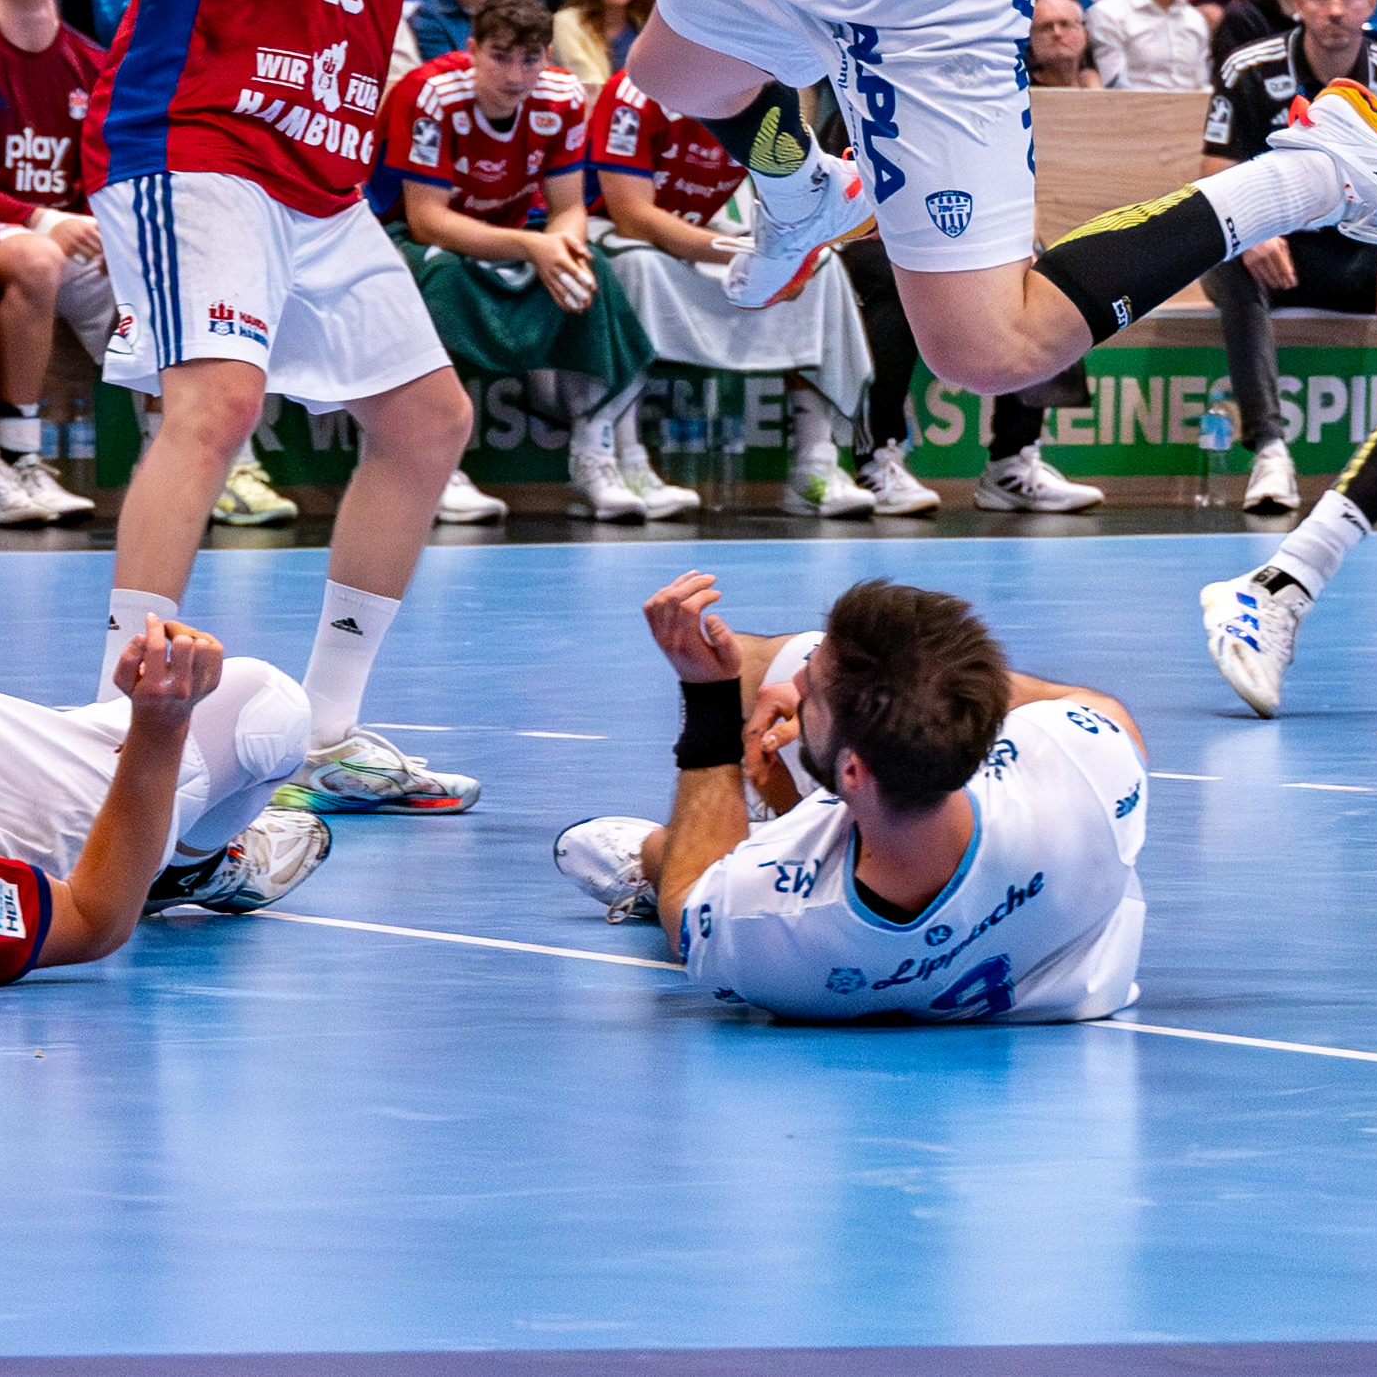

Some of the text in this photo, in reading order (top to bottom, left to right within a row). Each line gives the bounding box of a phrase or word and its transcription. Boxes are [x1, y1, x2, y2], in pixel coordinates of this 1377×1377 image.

[255, 52, 309, 85] WIR
[231, 88, 376, 165] HAMBURG
[4, 126, 72, 169] play
[15, 161, 68, 195] itas
